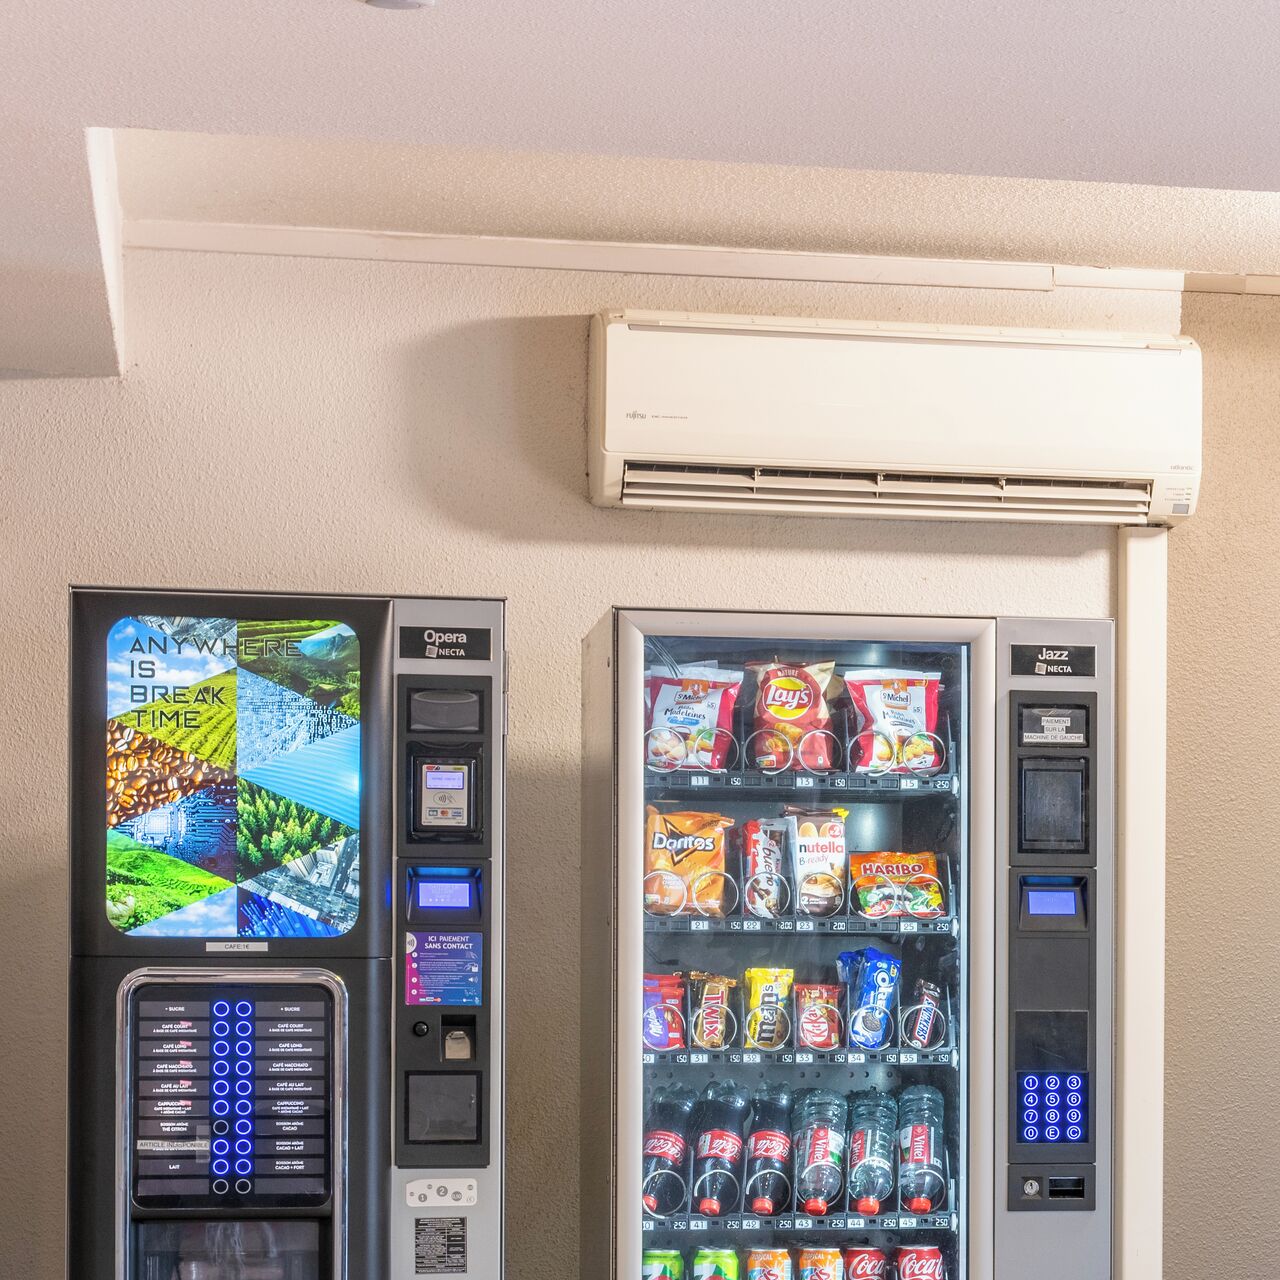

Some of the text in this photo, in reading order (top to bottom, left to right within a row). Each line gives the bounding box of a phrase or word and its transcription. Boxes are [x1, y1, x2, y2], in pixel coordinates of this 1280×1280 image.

[128, 635, 303, 657] ANYWHERE
[424, 629, 467, 646] Opera
[438, 647, 466, 657] NECTA
[1038, 648, 1068, 660] Jazz
[129, 660, 156, 679] IS
[777, 669, 799, 677] NATURE
[129, 684, 225, 706] BREAK
[767, 685, 810, 709] Lay's
[887, 693, 909, 703] Michel
[130, 710, 201, 729] TIME
[664, 708, 706, 720] Madeleines
[652, 832, 716, 851] Doritos
[799, 842, 844, 854] nutella
[762, 847, 775, 888] bueno
[861, 863, 924, 876] HARIBO
[703, 990, 726, 1040] TWIX
[915, 998, 936, 1041] SNICKERS
[813, 1138, 825, 1162] Vittel
[852, 1140, 862, 1165] Vittel
[913, 1136, 926, 1160] Vittel
